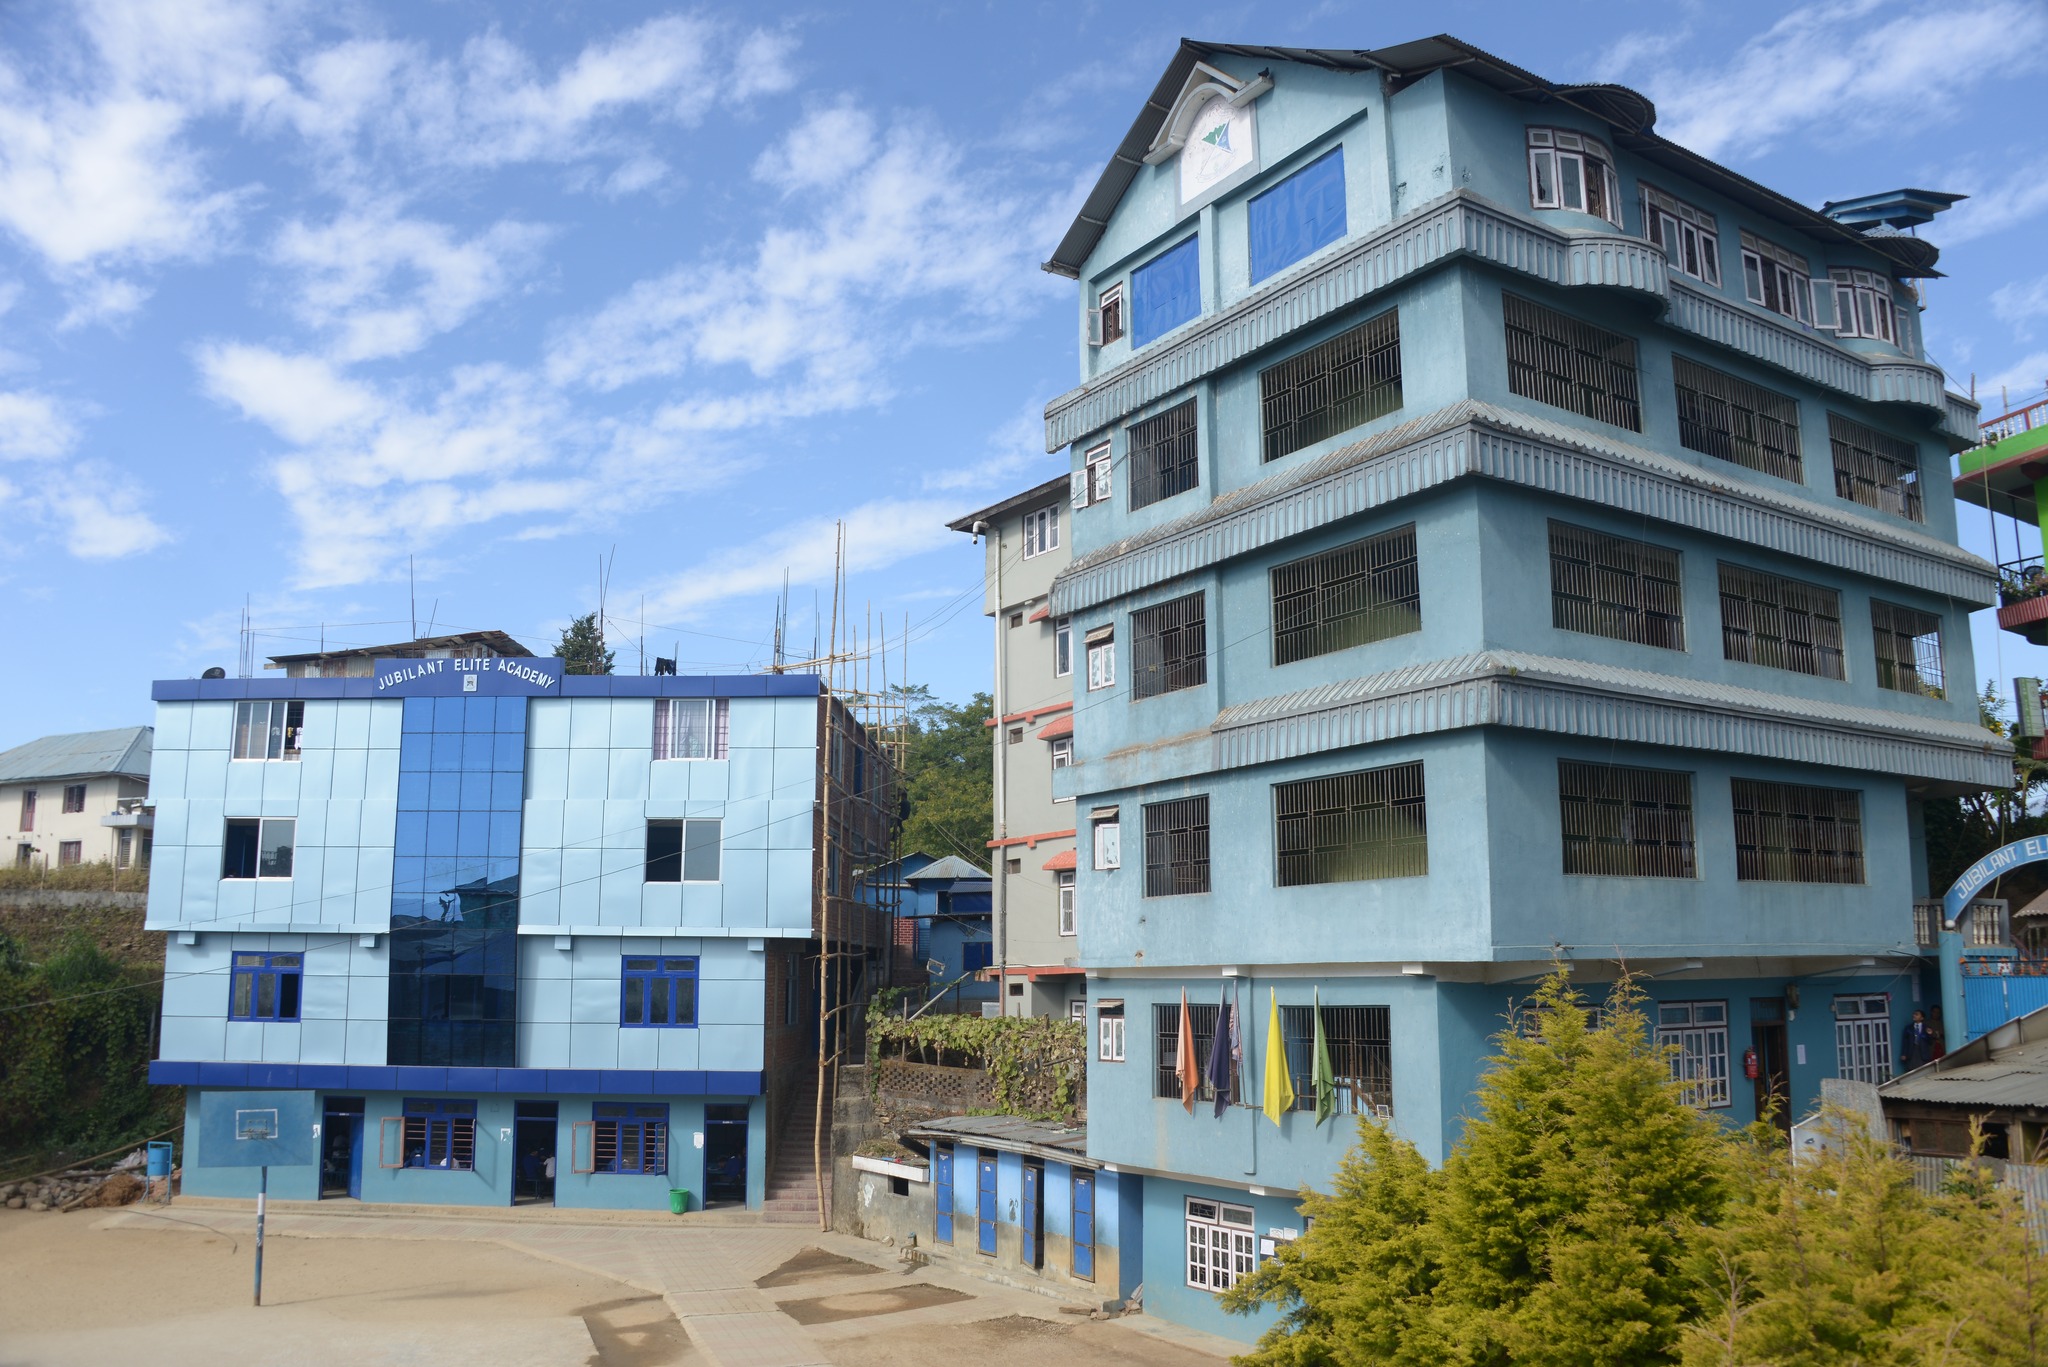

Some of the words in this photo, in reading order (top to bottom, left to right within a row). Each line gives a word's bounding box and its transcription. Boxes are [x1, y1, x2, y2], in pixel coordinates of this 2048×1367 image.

[378, 660, 444, 691] JUBILANT
[454, 658, 491, 672] ELITE
[498, 659, 555, 689] ACADEMY
[1954, 846, 2017, 899] JUBILANT
